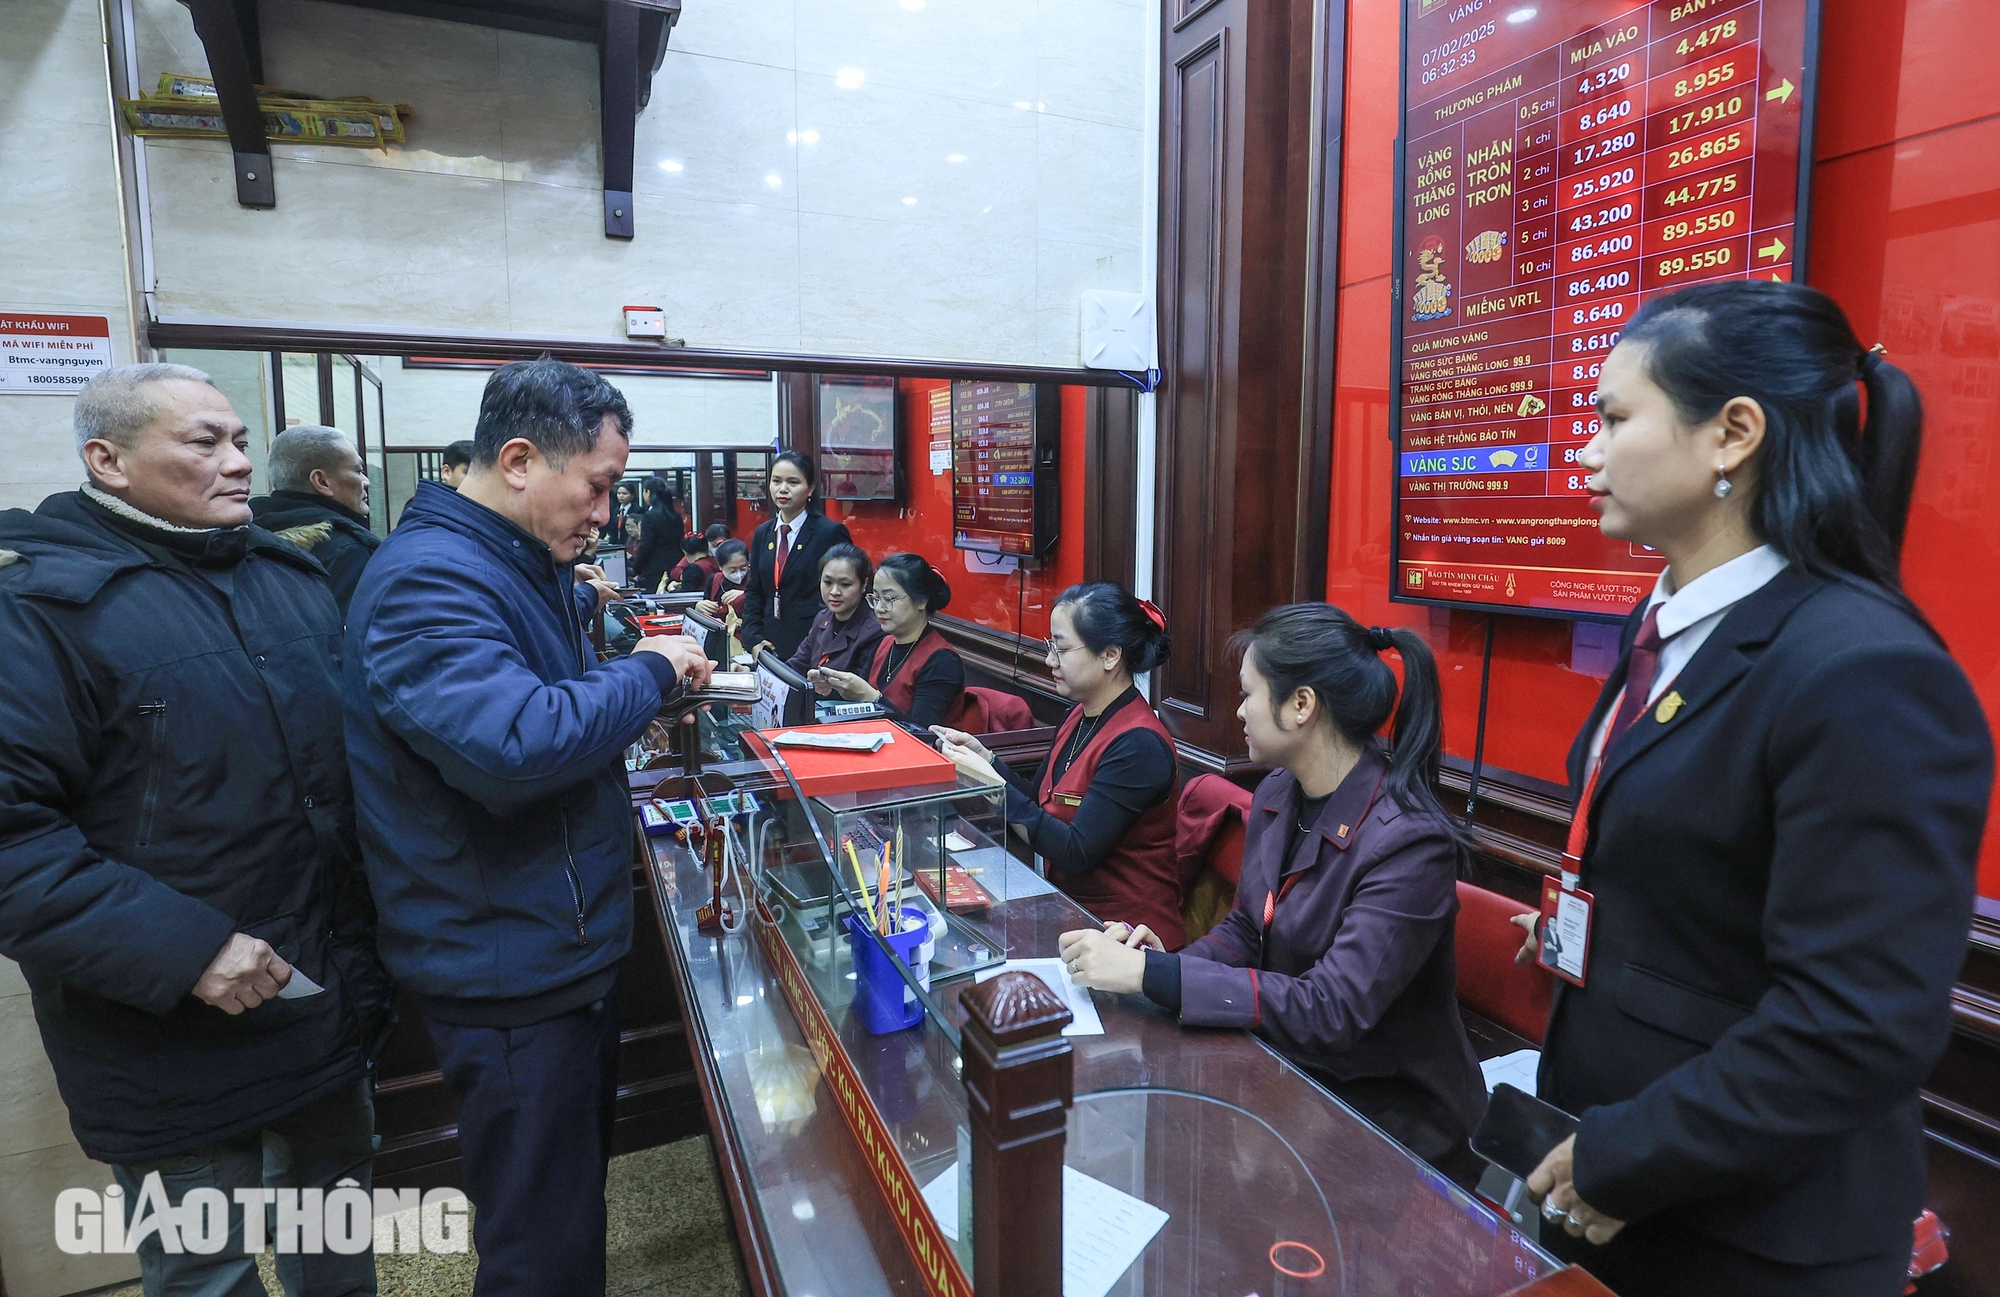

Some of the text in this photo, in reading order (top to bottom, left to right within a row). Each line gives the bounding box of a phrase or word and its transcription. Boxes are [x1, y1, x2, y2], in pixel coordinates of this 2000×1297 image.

[1422, 20, 1496, 66] 07/02/2025
[1570, 26, 1638, 64] MUA VÀO
[1676, 20, 1737, 56] 4.478
[1422, 50, 1476, 84] 06:32:33
[1578, 62, 1630, 94] 4.320
[1674, 62, 1734, 98] 8.955
[1434, 92, 1484, 121] THƯƠNG
[1520, 102, 1540, 119] 0,5
[1579, 100, 1631, 130] 8.640
[1669, 96, 1742, 134] 17.910
[1524, 136, 1531, 148] 1
[1574, 132, 1636, 165] 17.280
[1668, 132, 1741, 168] 26.865
[1417, 146, 1452, 170] VÀNG
[1466, 160, 1512, 188] TRÒN
[1523, 168, 1532, 181] 2
[1572, 168, 1634, 200] 25.920
[1413, 183, 1456, 208] THĂNG
[1466, 181, 1512, 208] TRƠN
[1664, 174, 1737, 207] 44.775
[1417, 204, 1450, 225] LONG
[1522, 200, 1530, 212] 3
[1570, 203, 1632, 232] 43.200
[1521, 231, 1529, 244] 5
[1662, 210, 1736, 242] 89.550
[1570, 234, 1633, 262] 86.400
[1520, 262, 1534, 276] 10
[1658, 248, 1731, 276] 89.550
[1568, 271, 1630, 297] 86.400
[1466, 291, 1542, 318] MIẾNG VRTL
[1572, 302, 1623, 324] 8.640
[0, 319, 70, 330] ẬT KHẨU WIFI
[2, 340, 19, 348] MÃ
[22, 341, 44, 349] WIFI
[76, 342, 94, 350] PHÍ
[1412, 340, 1431, 354] QUÀ
[1462, 331, 1489, 345] VÀNG
[1571, 332, 1620, 353] 8.610
[8, 355, 103, 366] Btmc-vangnguyen
[1410, 360, 1436, 371] TRANG
[1410, 370, 1430, 382] VÀNG
[1485, 359, 1509, 370] LONG
[1512, 354, 1531, 366] 99.9
[1572, 362, 1603, 380] 8.6
[28, 376, 90, 384] 1800585899
[1410, 383, 1434, 394] TRANG
[1410, 394, 1430, 404] VÀNG
[1484, 384, 1508, 396] LONG
[1510, 380, 1534, 392] 999.9
[1410, 410, 1432, 423] VÀNG
[1494, 402, 1514, 414] NÉN
[1410, 427, 1516, 447] VÀNG HỆ THỐNG BẢO TÍN
[1572, 420, 1604, 435] 8.6
[1410, 455, 1477, 474] VÀNG SJC
[1409, 478, 1509, 492] VÀNG THỊ TRƯỜNG 999.9
[1412, 516, 1441, 525] Website:
[1442, 516, 1490, 526] www.btmc.vn
[1496, 516, 1600, 528] www.vangrongthanglong.
[1431, 534, 1440, 542] tin
[1492, 536, 1504, 544] tin:
[1506, 536, 1529, 544] VANG
[1546, 538, 1566, 546] 8009
[1456, 572, 1476, 580] MINH
[1478, 572, 1500, 582] CHÂU
[1550, 580, 1572, 589] CÔNG
[837, 1066, 856, 1118] KHI
[858, 1104, 875, 1158] RA
[877, 1141, 910, 1228] KHỎI
